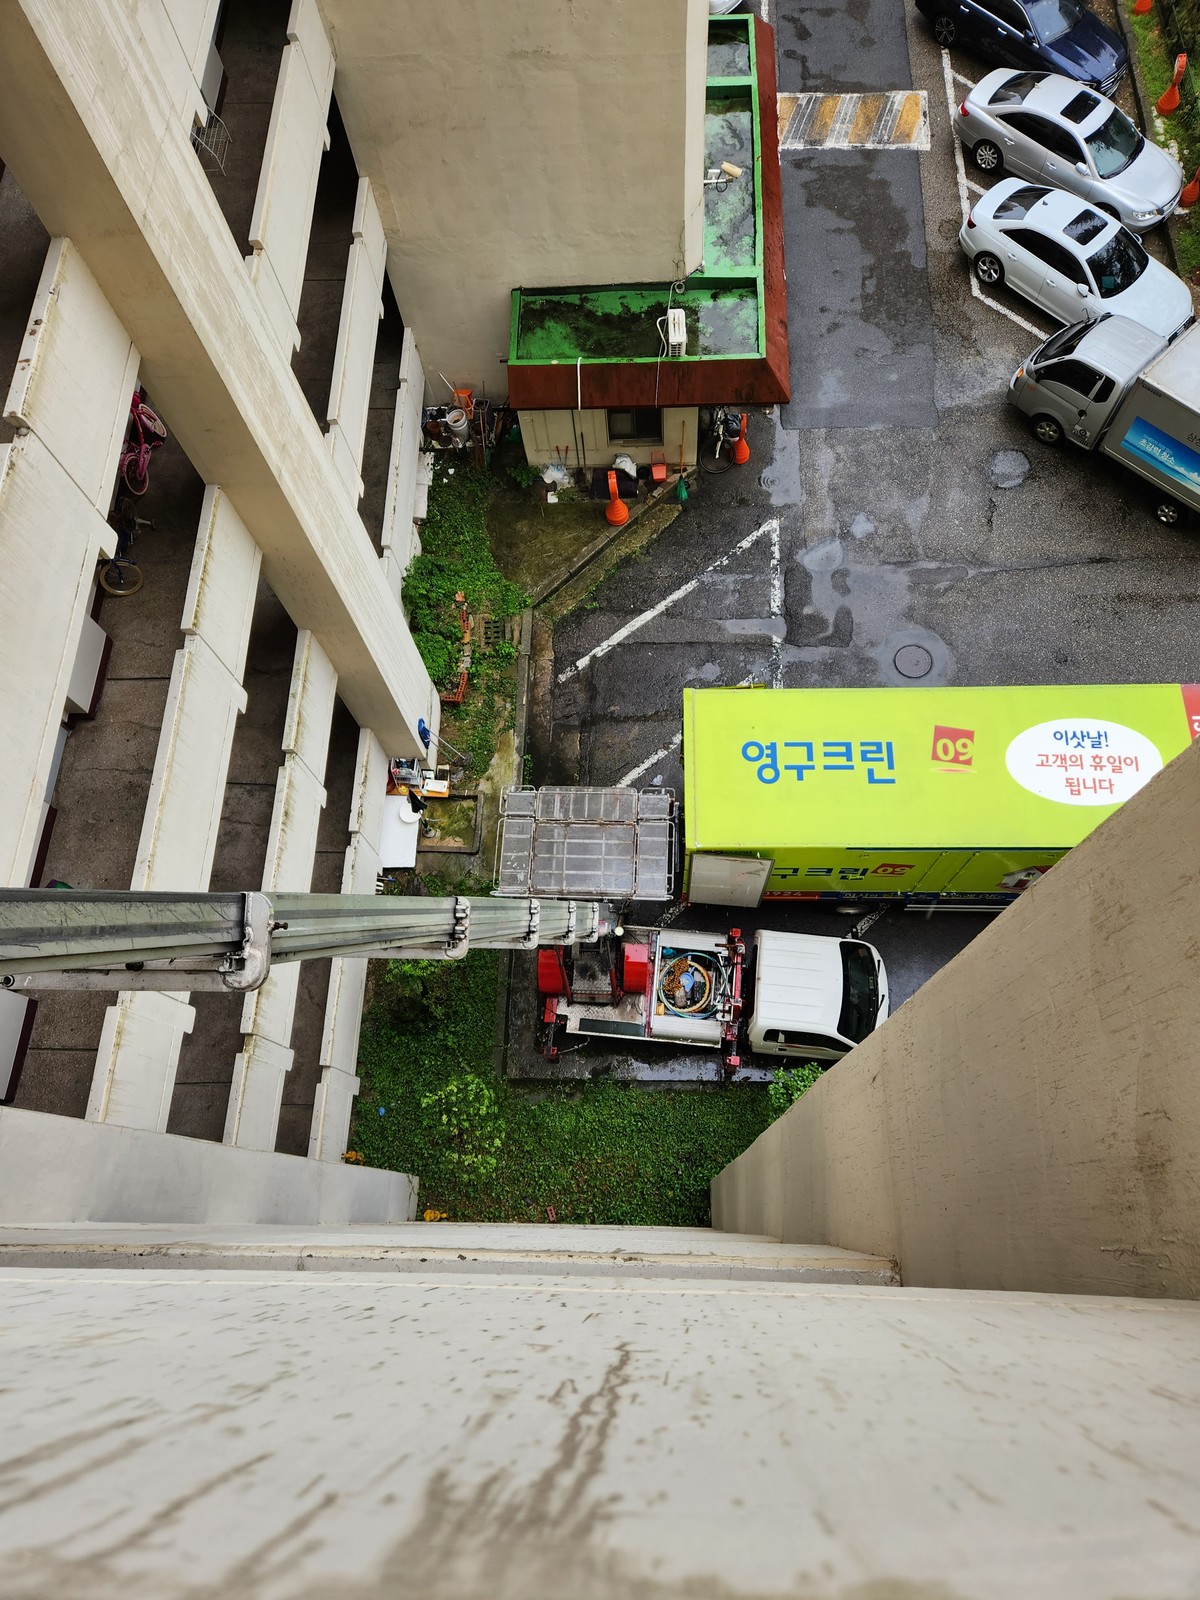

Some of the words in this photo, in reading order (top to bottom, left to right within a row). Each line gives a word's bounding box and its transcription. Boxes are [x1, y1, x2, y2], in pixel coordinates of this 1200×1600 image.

[1053, 730, 1110, 749] 이삿날!
[936, 738, 975, 762] 09
[741, 740, 896, 785] 영구크린
[1035, 753, 1085, 772] 고객의
[1089, 754, 1140, 774] 휴일이
[1064, 777, 1116, 796] 됩니다
[771, 867, 868, 881] 구크린
